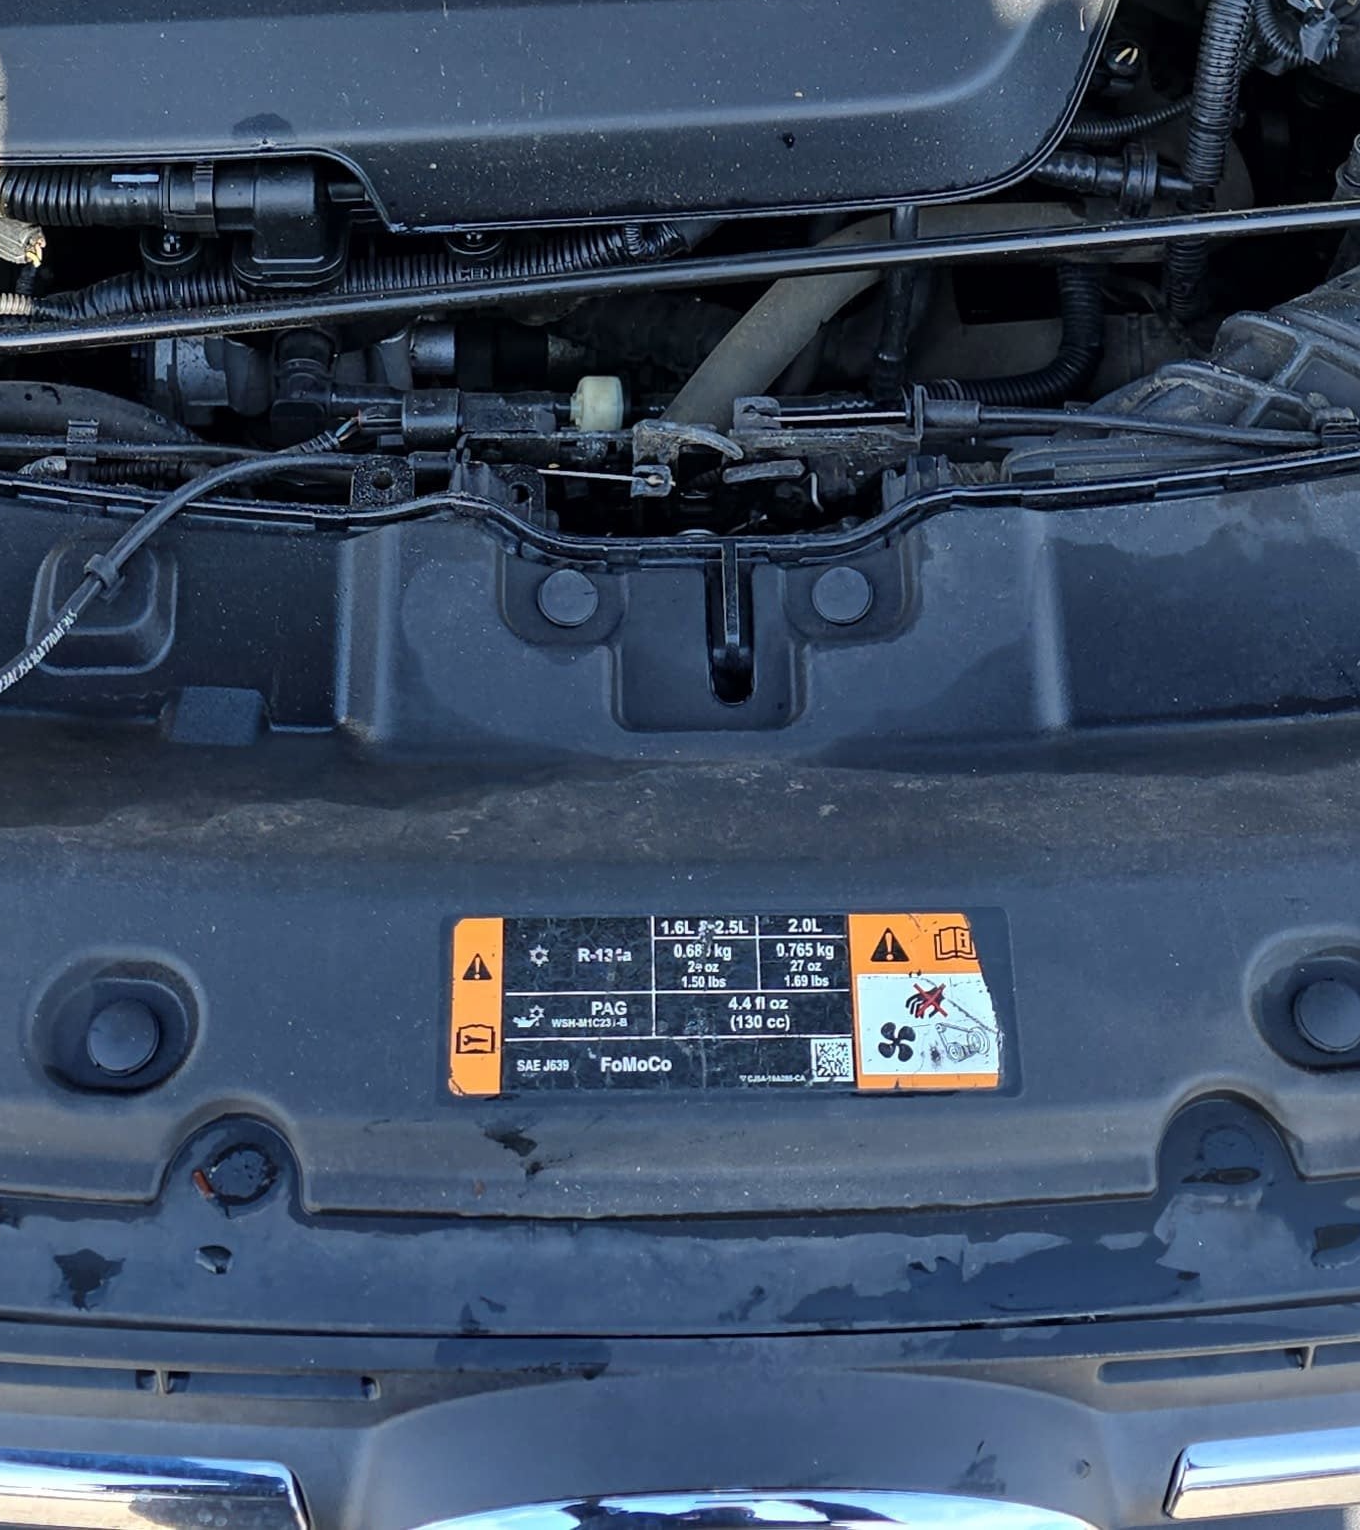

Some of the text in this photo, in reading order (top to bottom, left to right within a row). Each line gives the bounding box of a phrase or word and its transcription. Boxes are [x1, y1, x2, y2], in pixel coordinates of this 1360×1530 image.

[660, 920, 695, 935] 1.6L
[714, 920, 749, 935] 2.5L
[788, 919, 823, 933] 2.0L
[714, 943, 732, 961] kg
[775, 942, 835, 960] 0.765 kg
[704, 962, 720, 973] oz
[790, 960, 822, 972] 27 oz
[681, 975, 727, 988] 1.50 lbs
[783, 974, 829, 988] 1.69 lbs
[591, 1000, 628, 1016] PAG
[727, 996, 789, 1010] 4.4 fl oz
[730, 1014, 791, 1032] (130 cc)
[516, 1059, 570, 1072] SAE J639
[600, 1056, 673, 1073] FoMoCo
